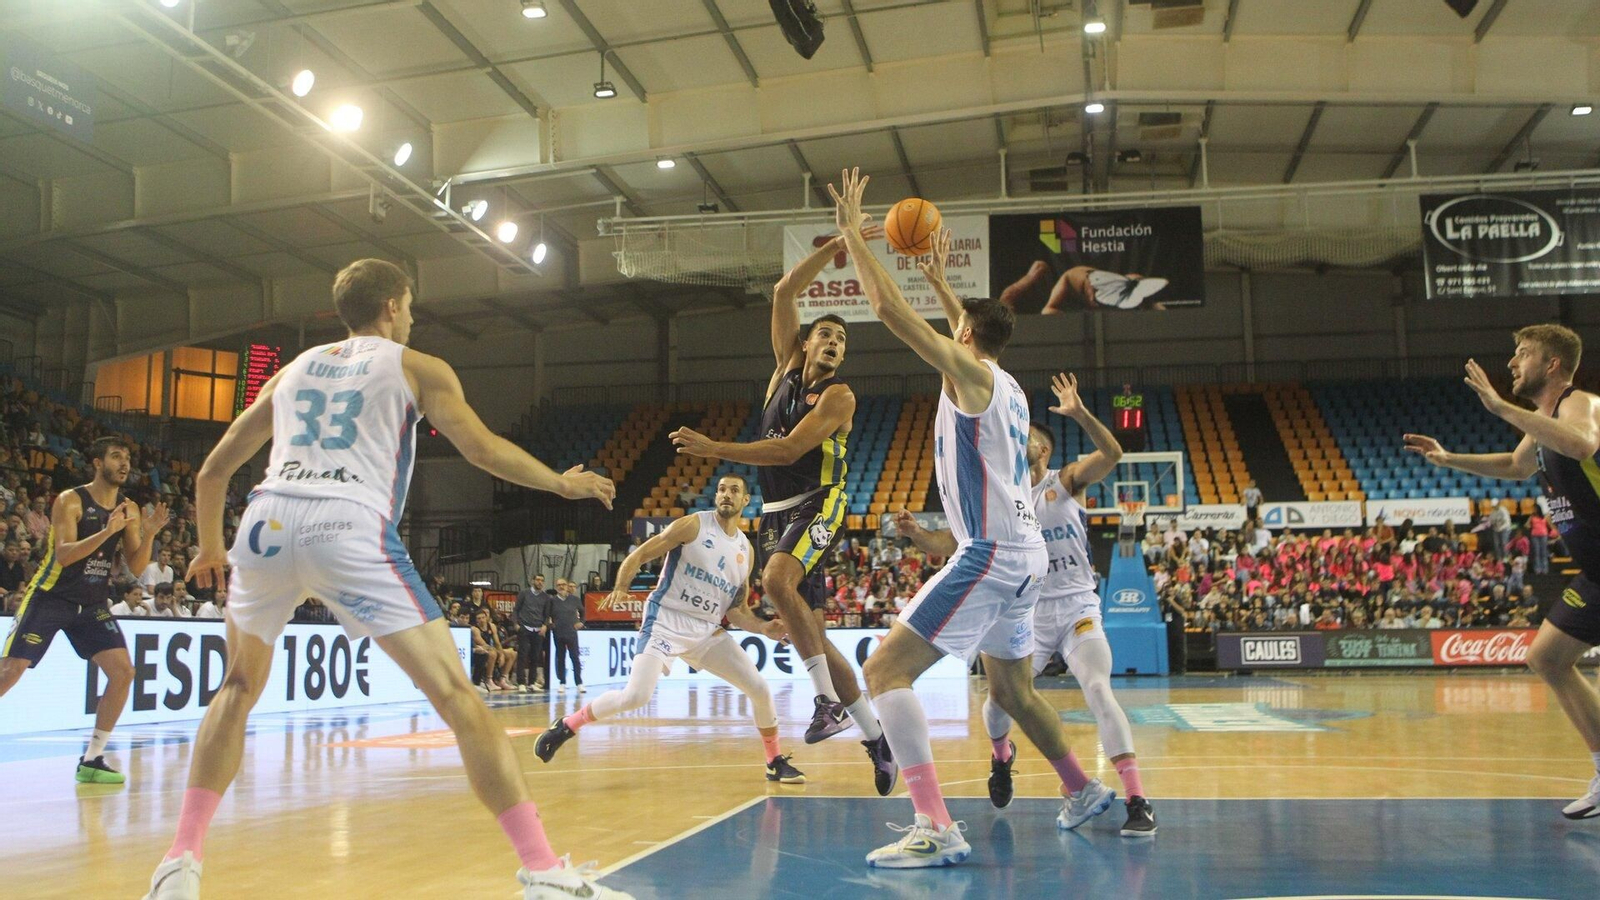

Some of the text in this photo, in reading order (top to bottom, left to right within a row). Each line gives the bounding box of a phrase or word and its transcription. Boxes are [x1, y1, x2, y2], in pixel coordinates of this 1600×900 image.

[1081, 224, 1152, 238] Fundación
[1478, 222, 1540, 240] PAELLA
[1082, 240, 1125, 253] Hestia
[897, 257, 909, 270] DE
[306, 356, 374, 378] LUKOVIĆ
[290, 389, 364, 449] 33
[1123, 410, 1142, 428] 11
[300, 521, 353, 535] carreras
[299, 532, 340, 547] center
[717, 556, 726, 571] 4
[684, 563, 738, 599] MENORCA
[1245, 640, 1297, 660] CAULES
[1440, 632, 1528, 663] Coca-Cola
[284, 633, 370, 700] 180€
